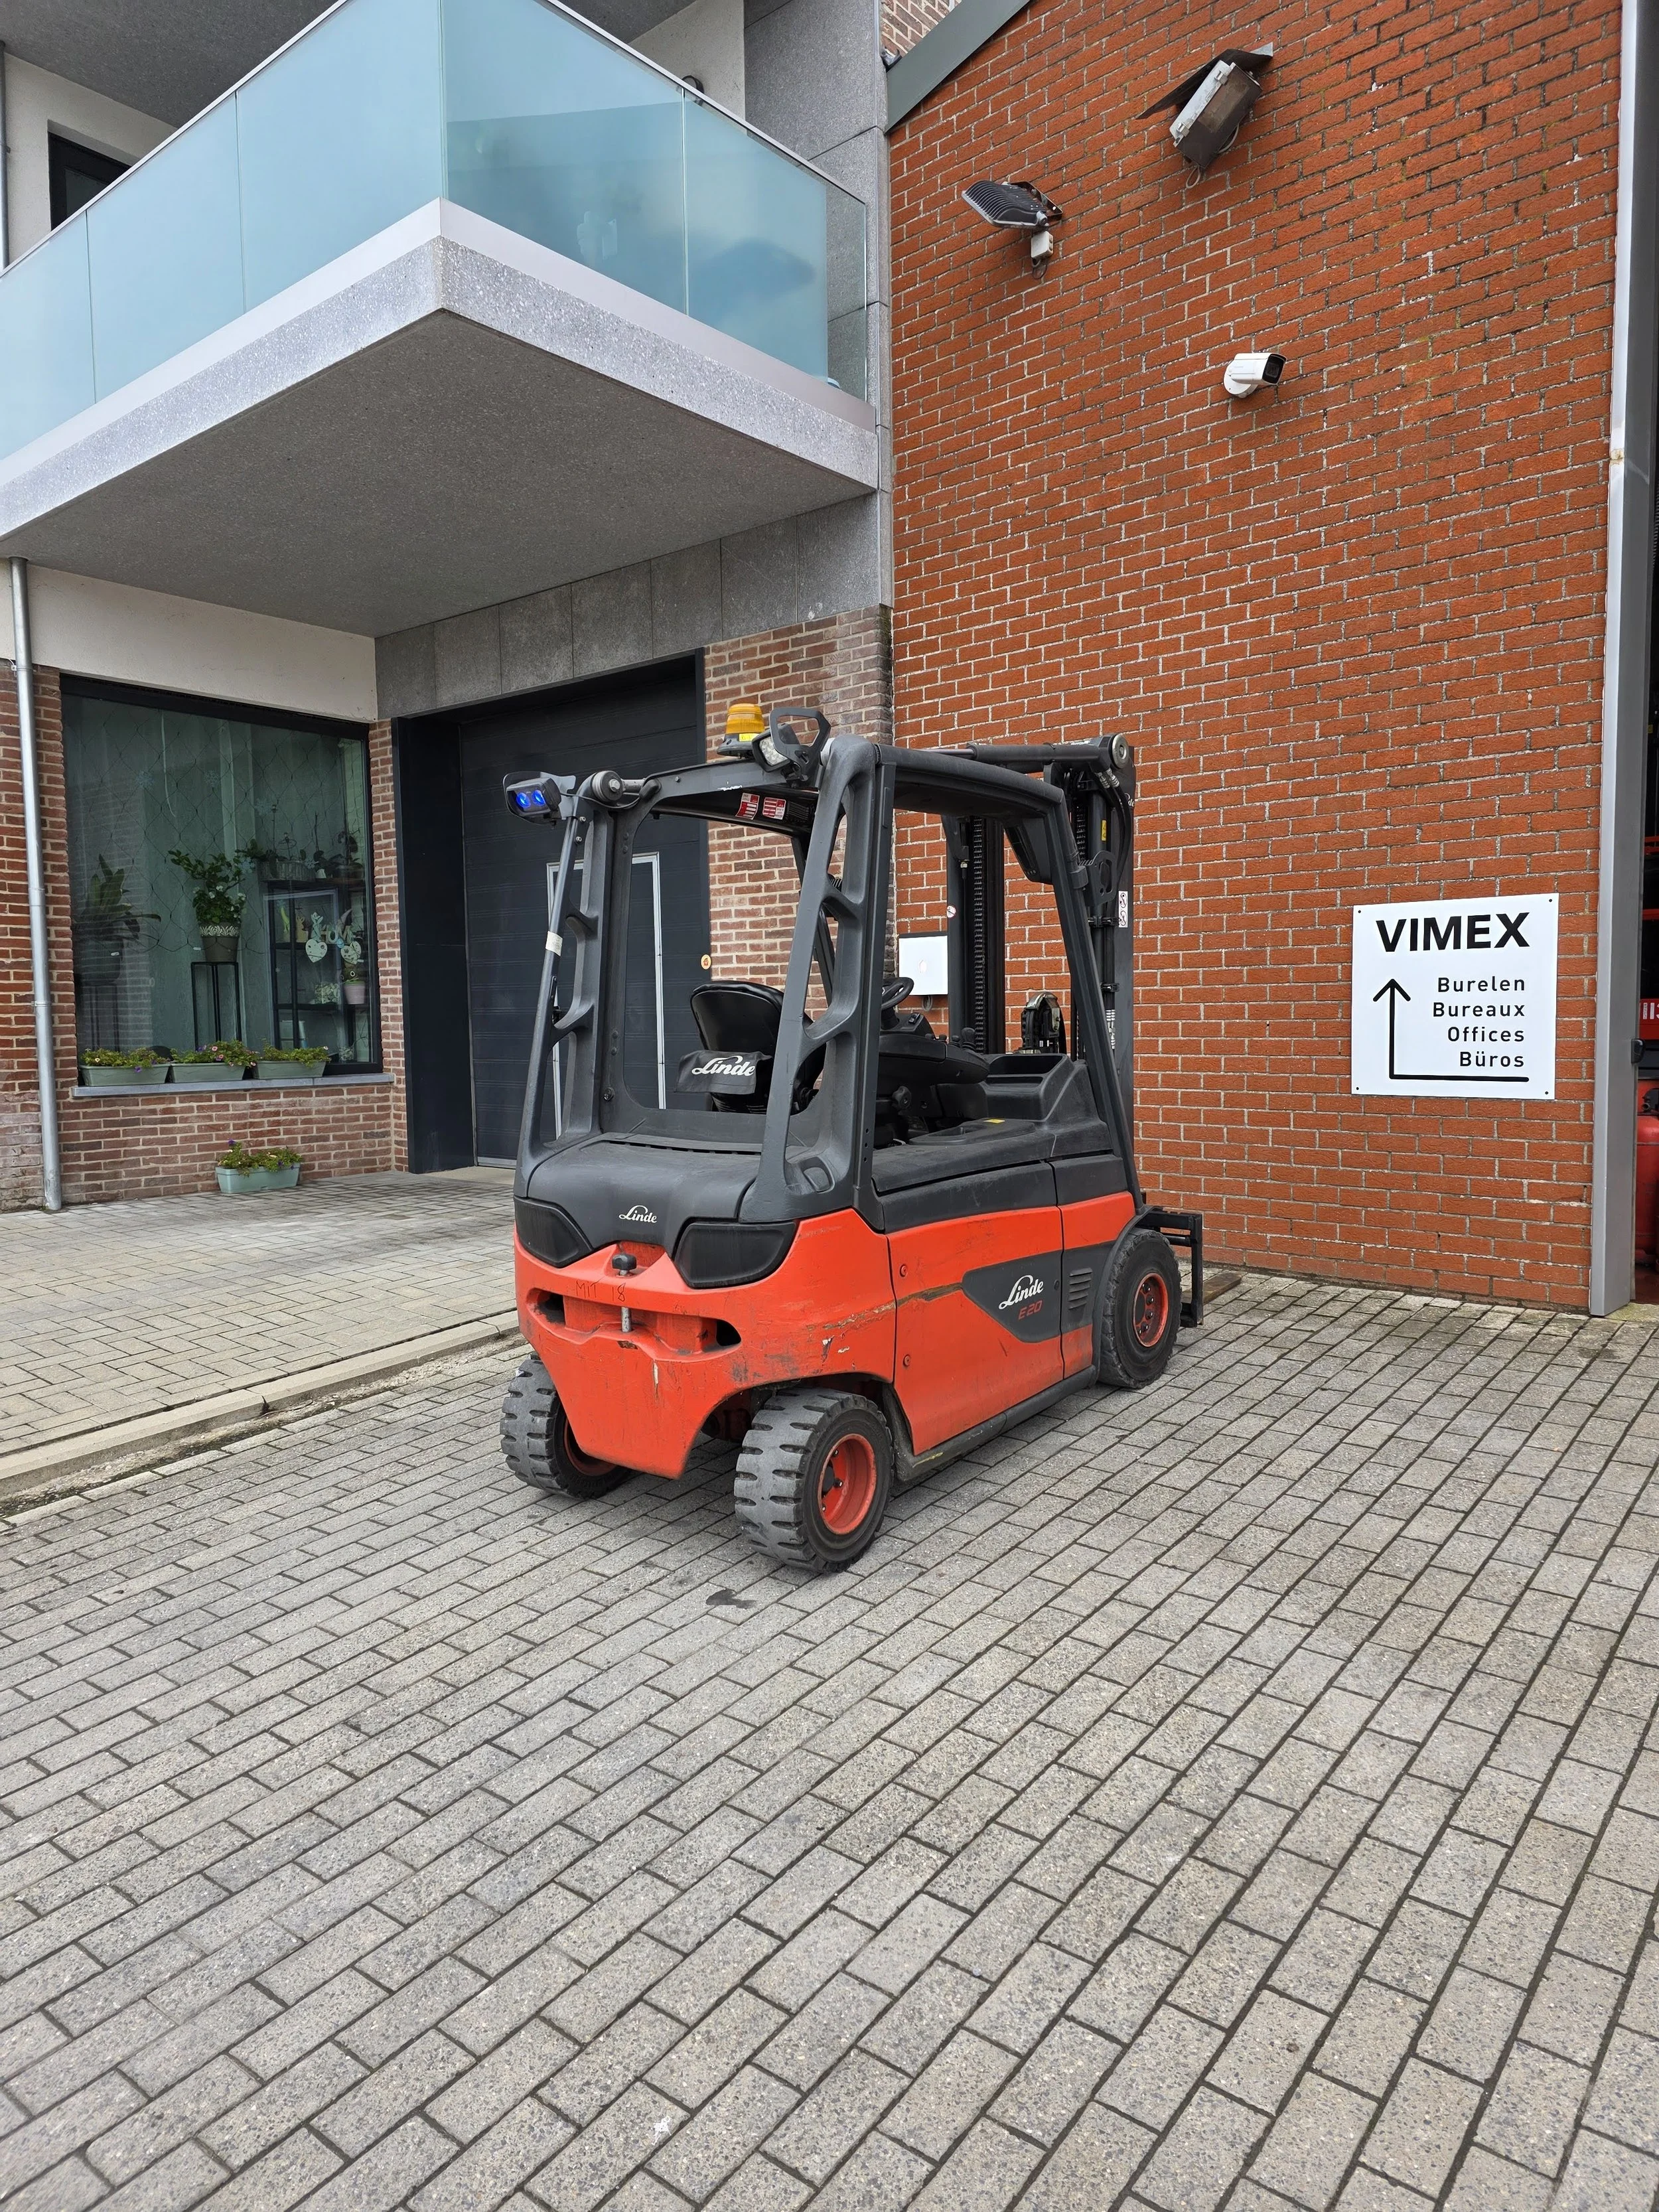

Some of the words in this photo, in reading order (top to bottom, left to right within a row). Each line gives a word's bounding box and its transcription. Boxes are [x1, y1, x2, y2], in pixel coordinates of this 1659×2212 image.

[1375, 912, 1530, 952] VIMEX
[1438, 976, 1525, 993] Burelen
[1433, 1001, 1525, 1017] Bureaux
[1448, 1026, 1524, 1042] Offices
[691, 1055, 755, 1076] Linde
[1460, 1051, 1524, 1067] Büros
[618, 1205, 657, 1223] Linde
[999, 1275, 1044, 1309] Linde
[1019, 1300, 1043, 1319] E20
